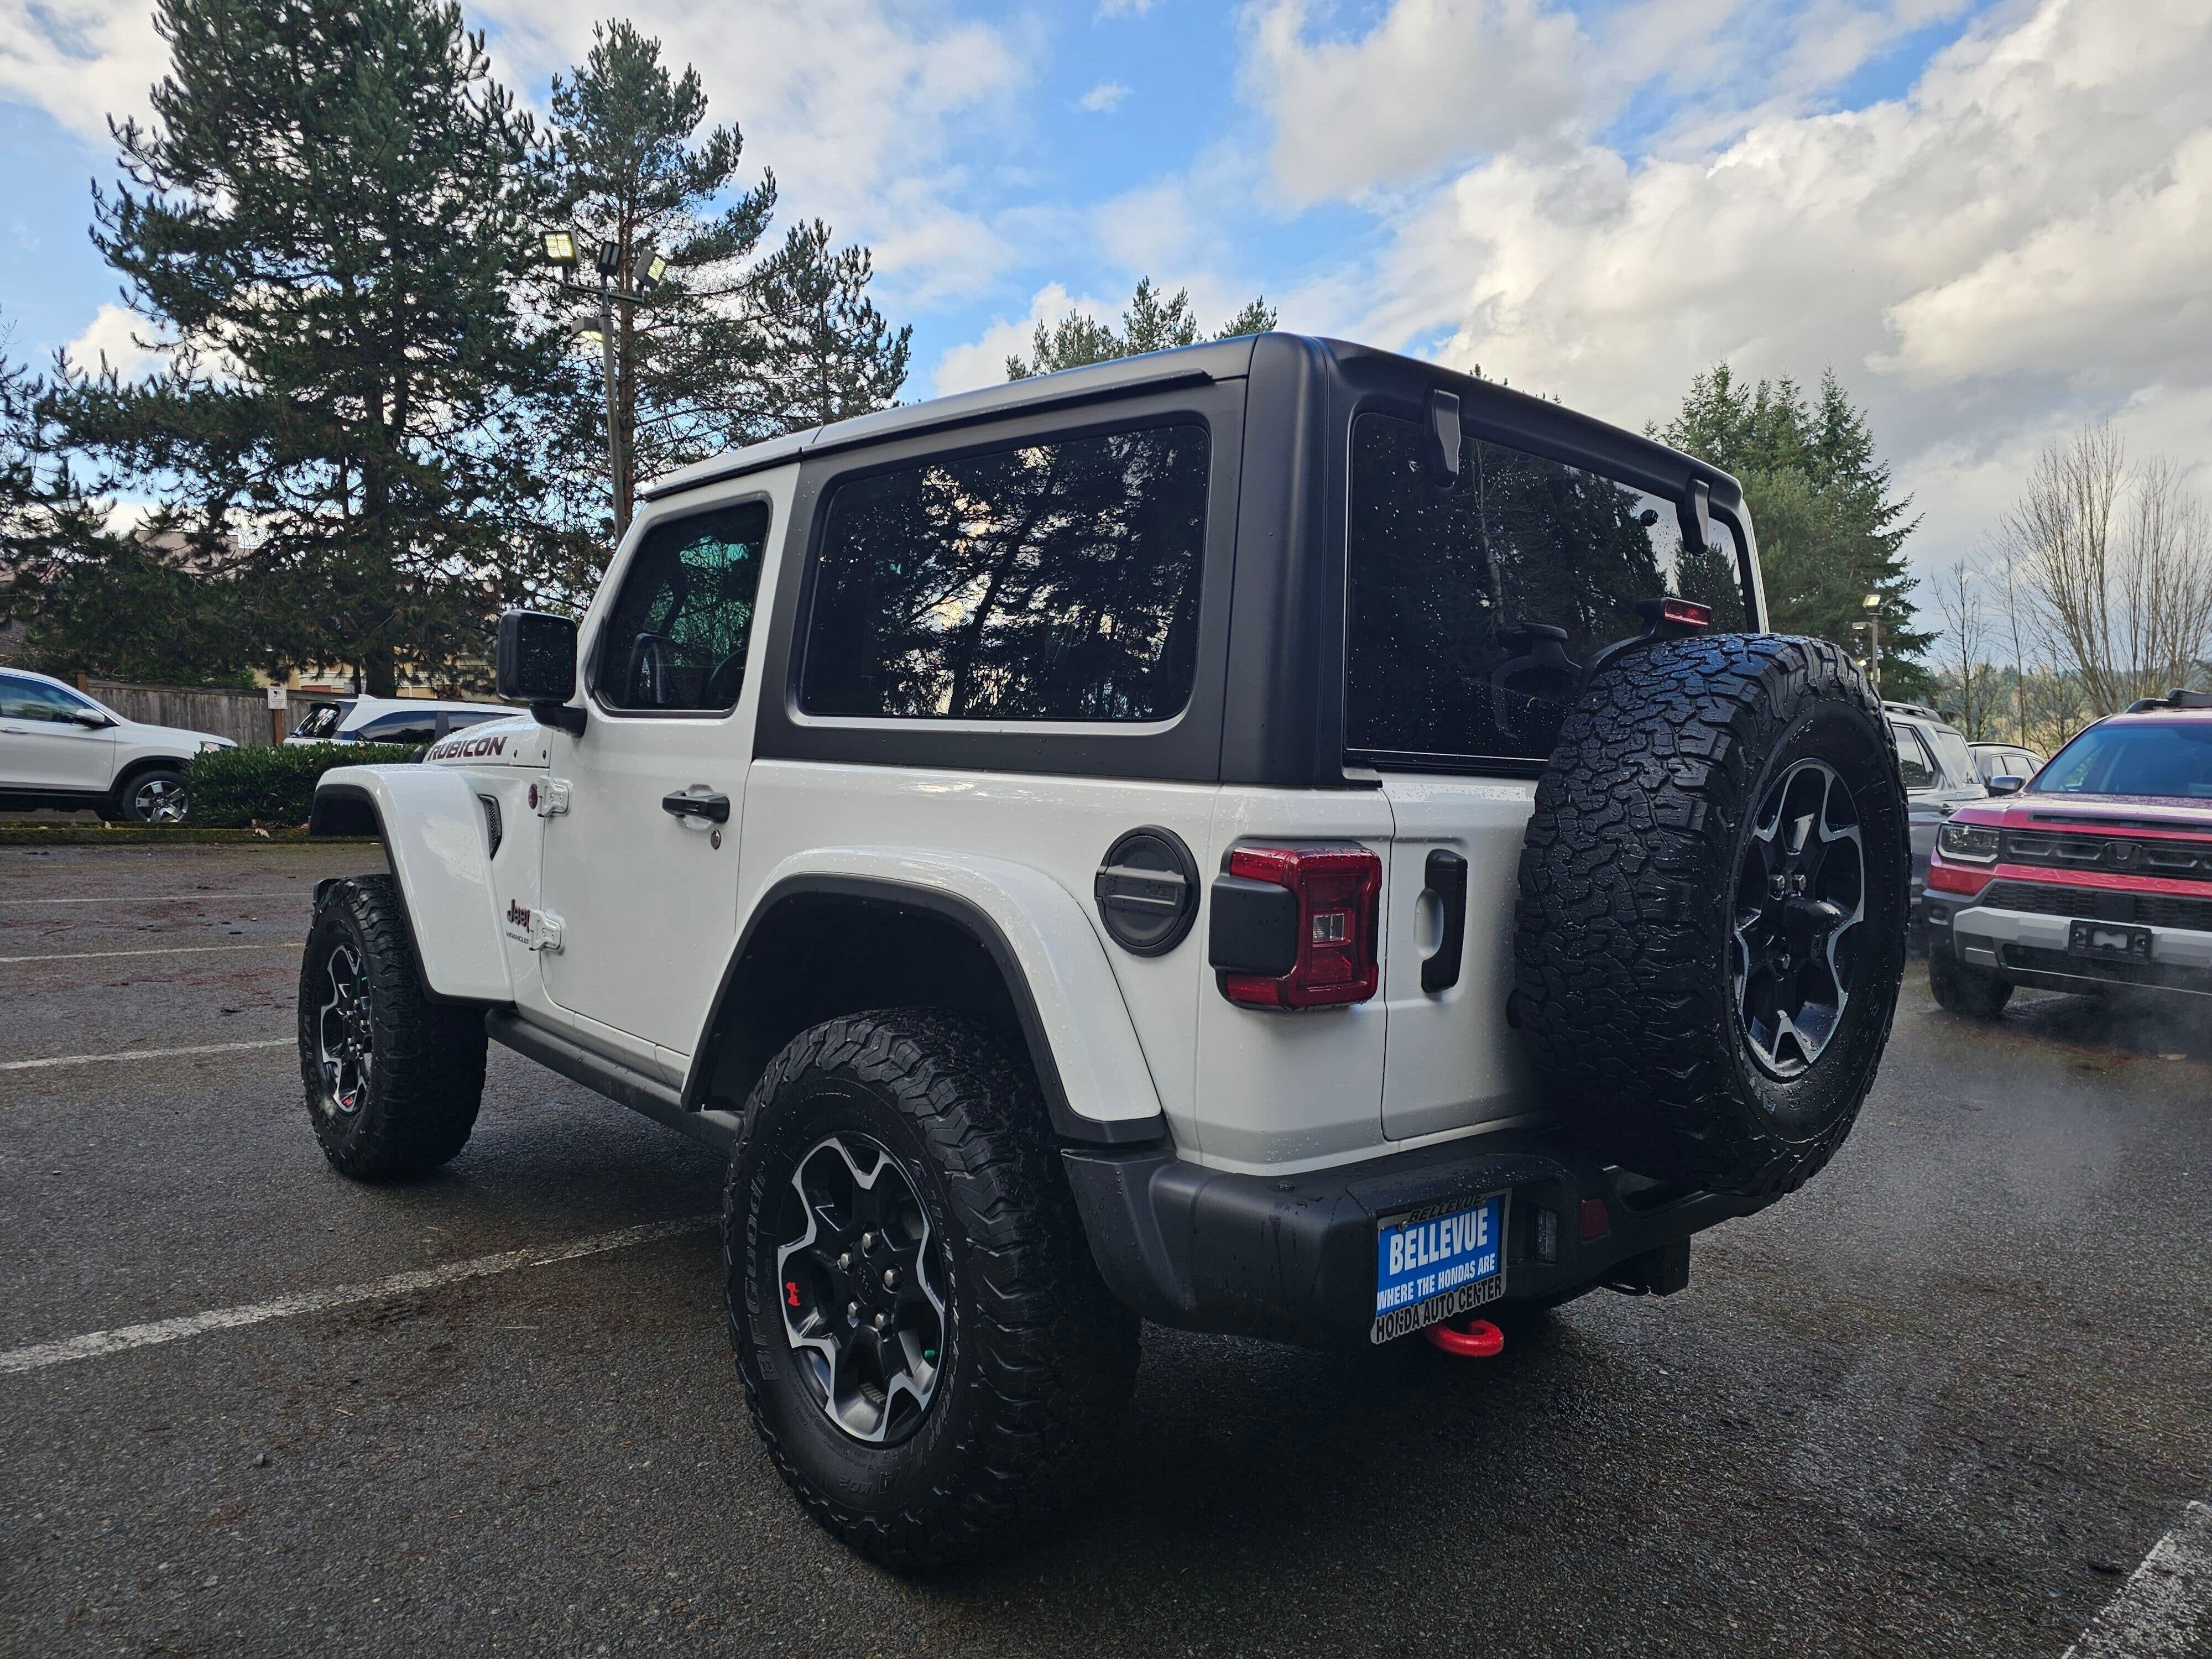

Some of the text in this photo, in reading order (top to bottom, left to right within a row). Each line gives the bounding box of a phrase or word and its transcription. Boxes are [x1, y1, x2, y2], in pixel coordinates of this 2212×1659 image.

[427, 736, 508, 761] RUBICON
[1410, 1195, 1483, 1222] BELLEVUE
[1389, 1207, 1488, 1276] BELLEVUE
[1376, 1277, 1502, 1342] HONDA AUTO CENTER
[1377, 1253, 1495, 1311] WHERE THE HONDAS ARE
